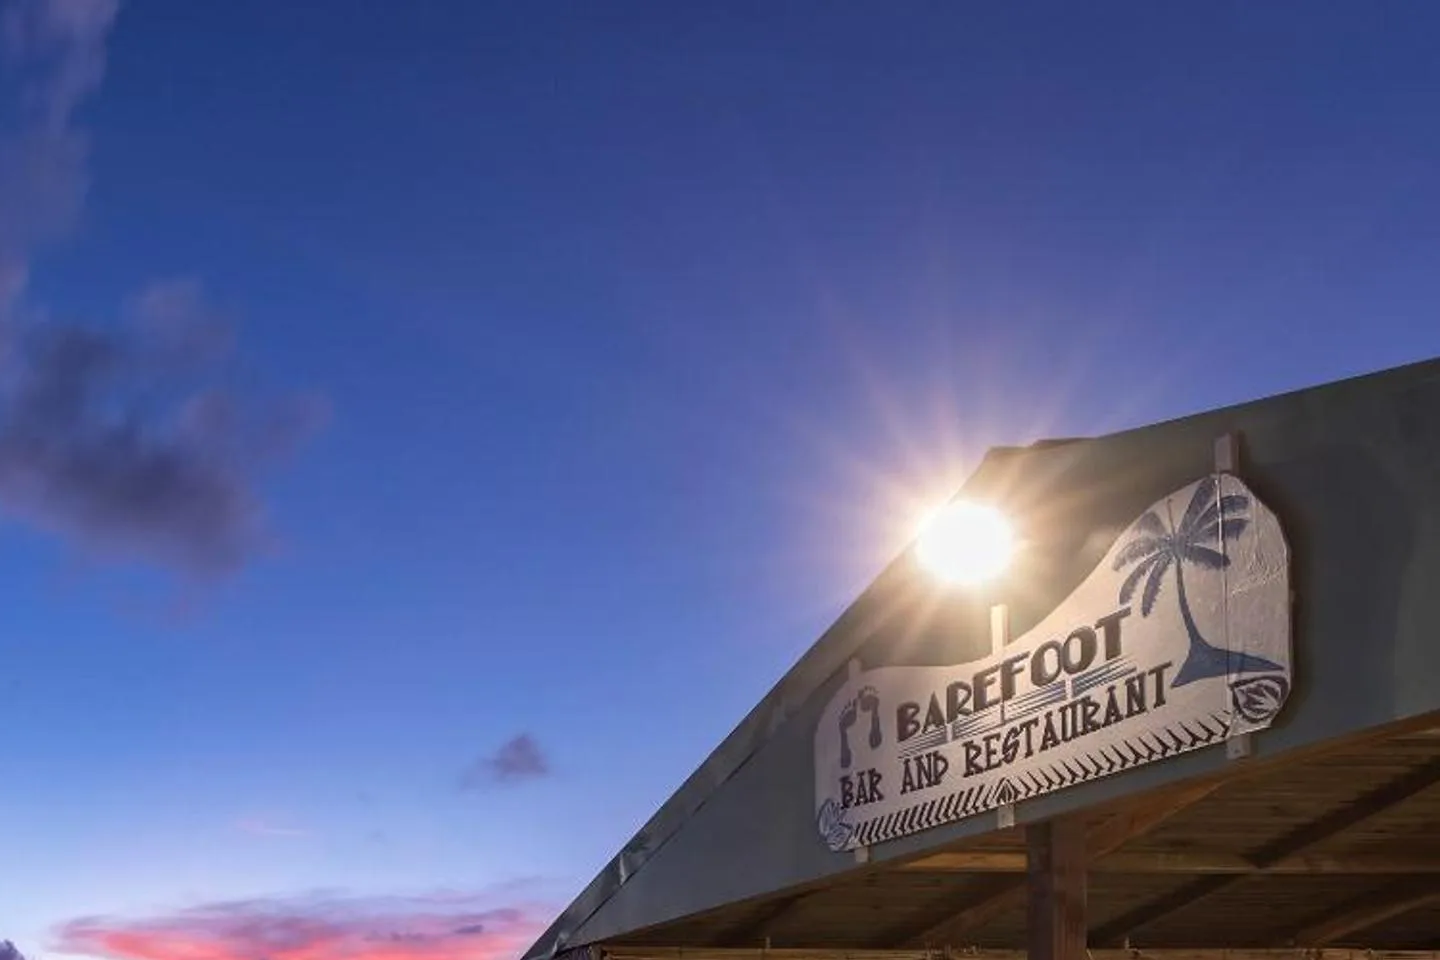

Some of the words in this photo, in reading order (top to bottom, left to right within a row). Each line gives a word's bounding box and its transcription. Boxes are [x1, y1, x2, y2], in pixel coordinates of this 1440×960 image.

[840, 769, 883, 810] BAR
[900, 751, 949, 795] AND
[963, 662, 1172, 778] RESTAURANT
[896, 608, 1132, 742] BAREFOOT
